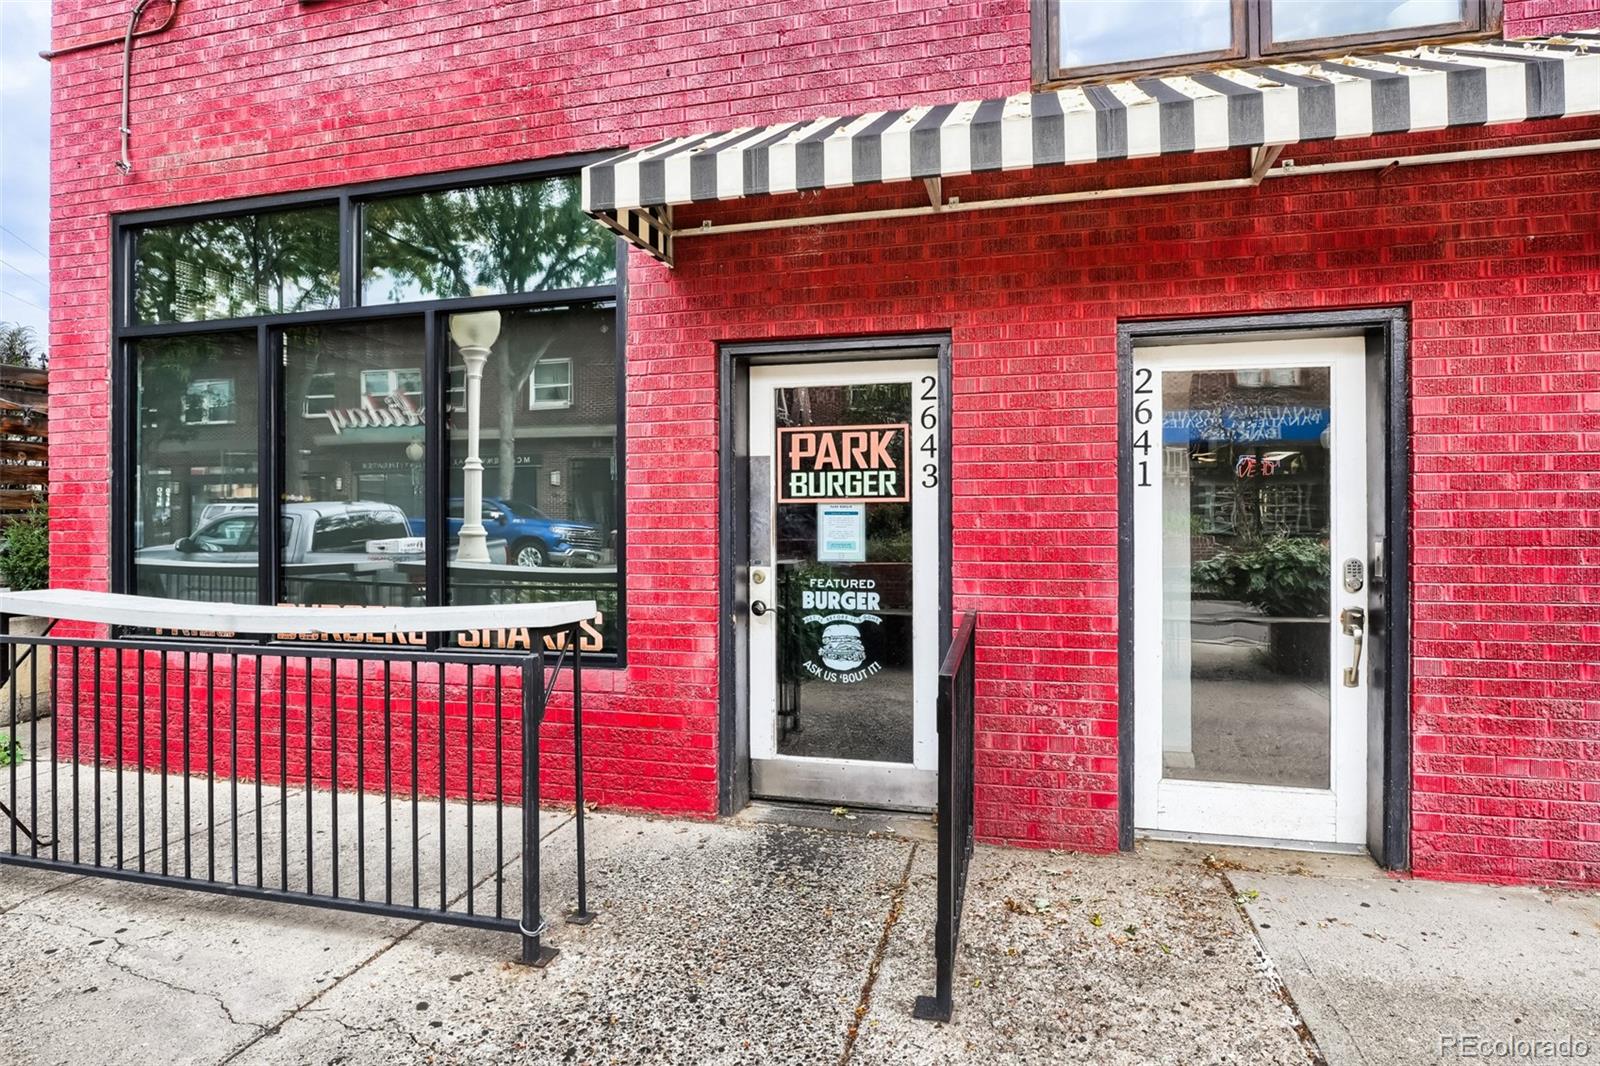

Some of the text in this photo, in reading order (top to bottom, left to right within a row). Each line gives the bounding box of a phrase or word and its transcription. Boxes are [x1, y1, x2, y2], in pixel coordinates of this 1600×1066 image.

[920, 375, 938, 488] 2643
[1133, 368, 1153, 487] 2641
[788, 430, 897, 471] PARK
[788, 470, 897, 498] BURGER
[809, 578, 876, 589] FEATURED
[802, 591, 881, 611] BURGER
[803, 661, 882, 683] ASK US 'BOUT IT!
